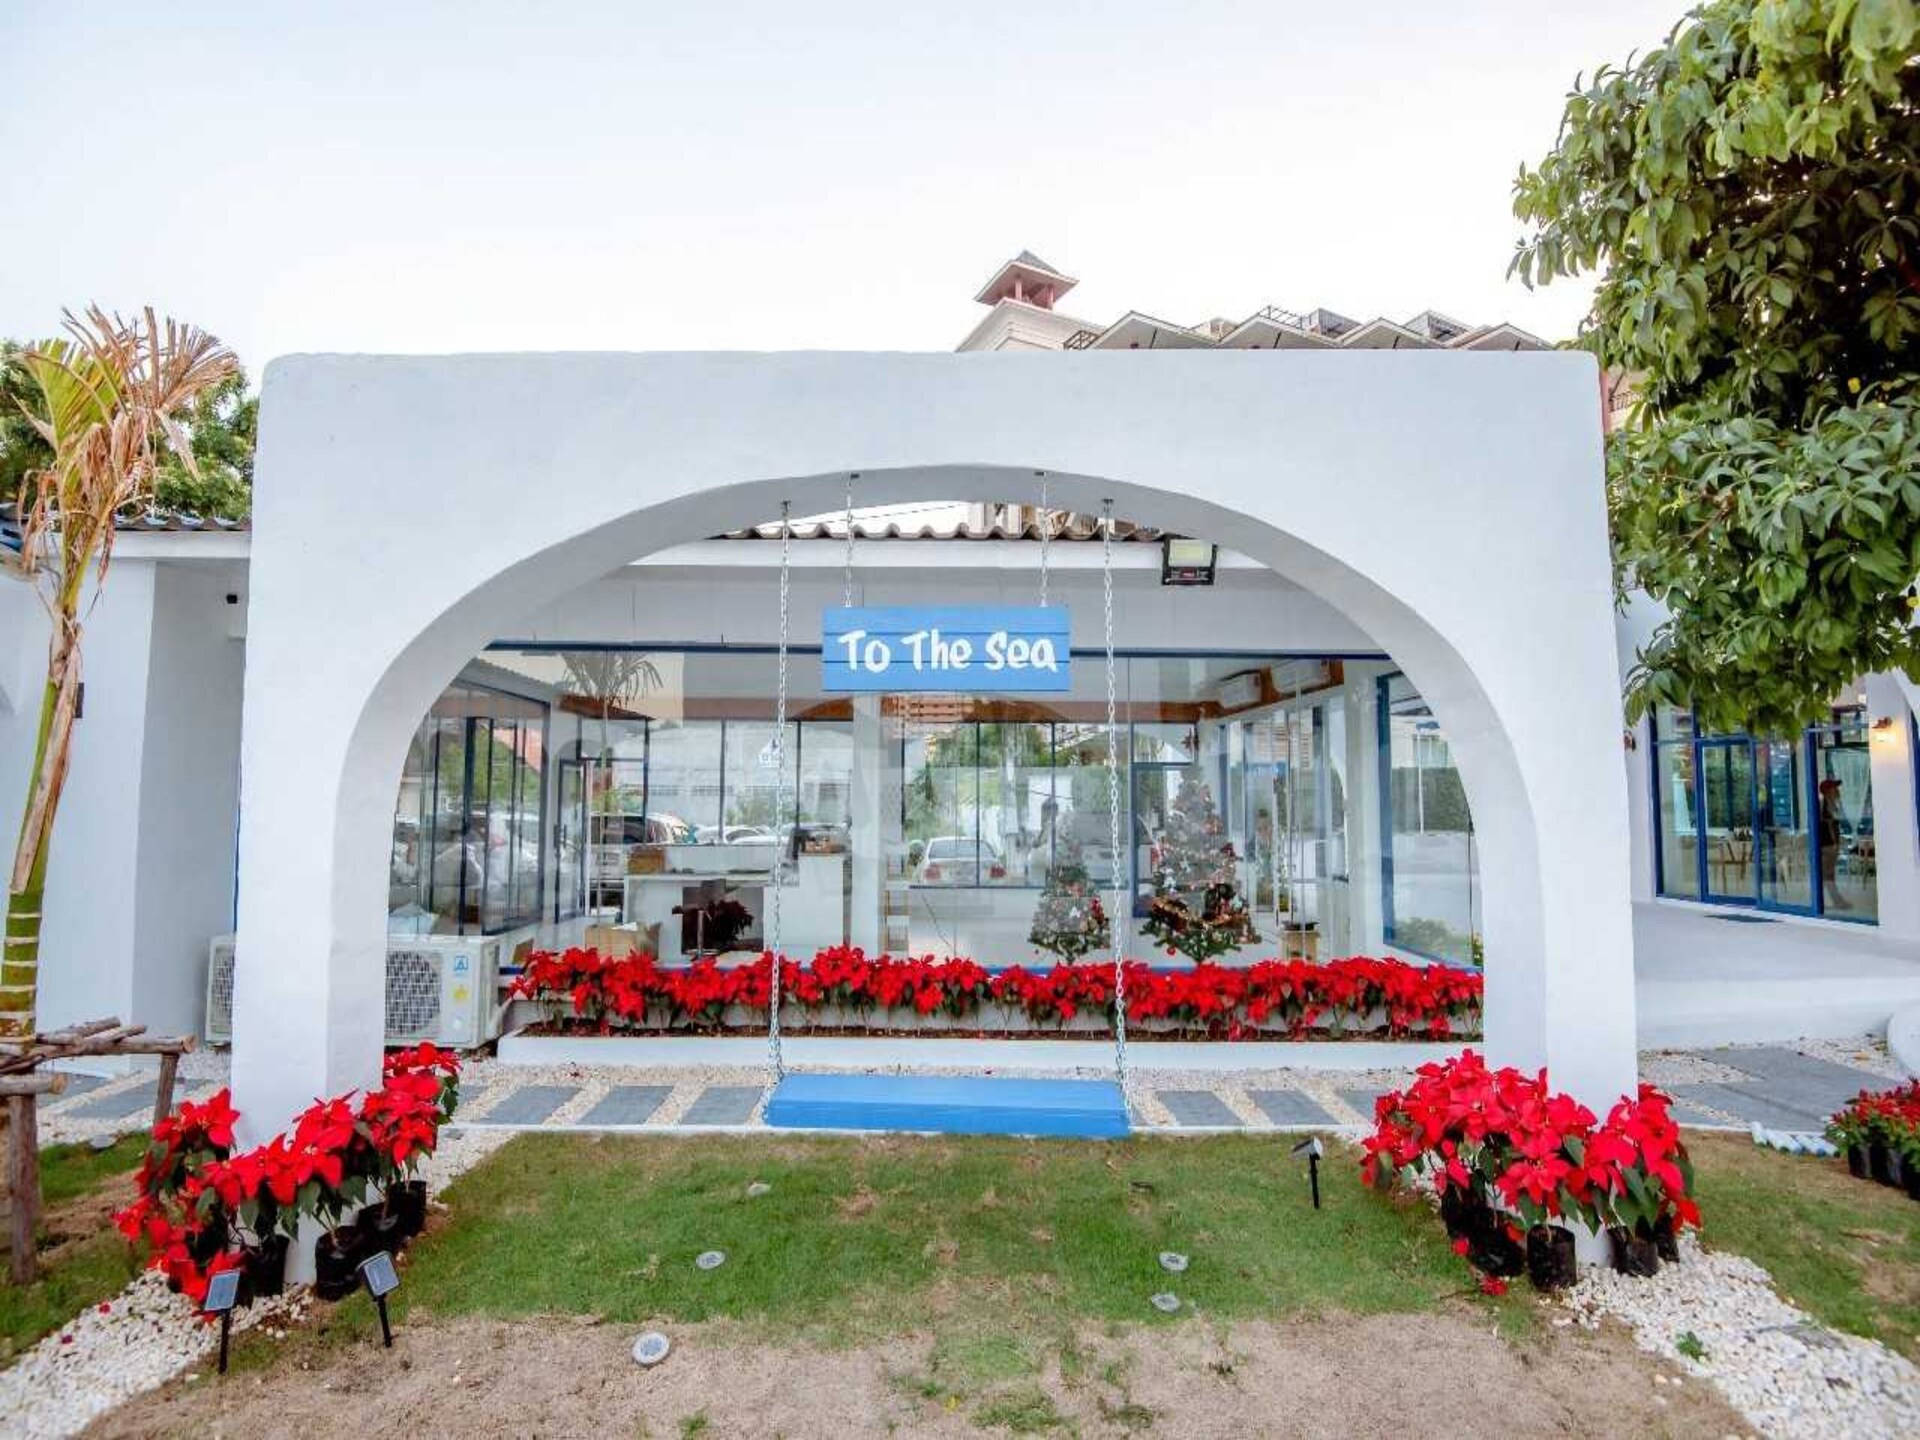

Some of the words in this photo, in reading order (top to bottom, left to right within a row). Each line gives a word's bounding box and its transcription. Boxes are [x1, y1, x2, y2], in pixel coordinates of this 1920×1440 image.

[838, 629, 891, 673] To
[901, 629, 972, 671] The
[985, 631, 1057, 673] Sea
